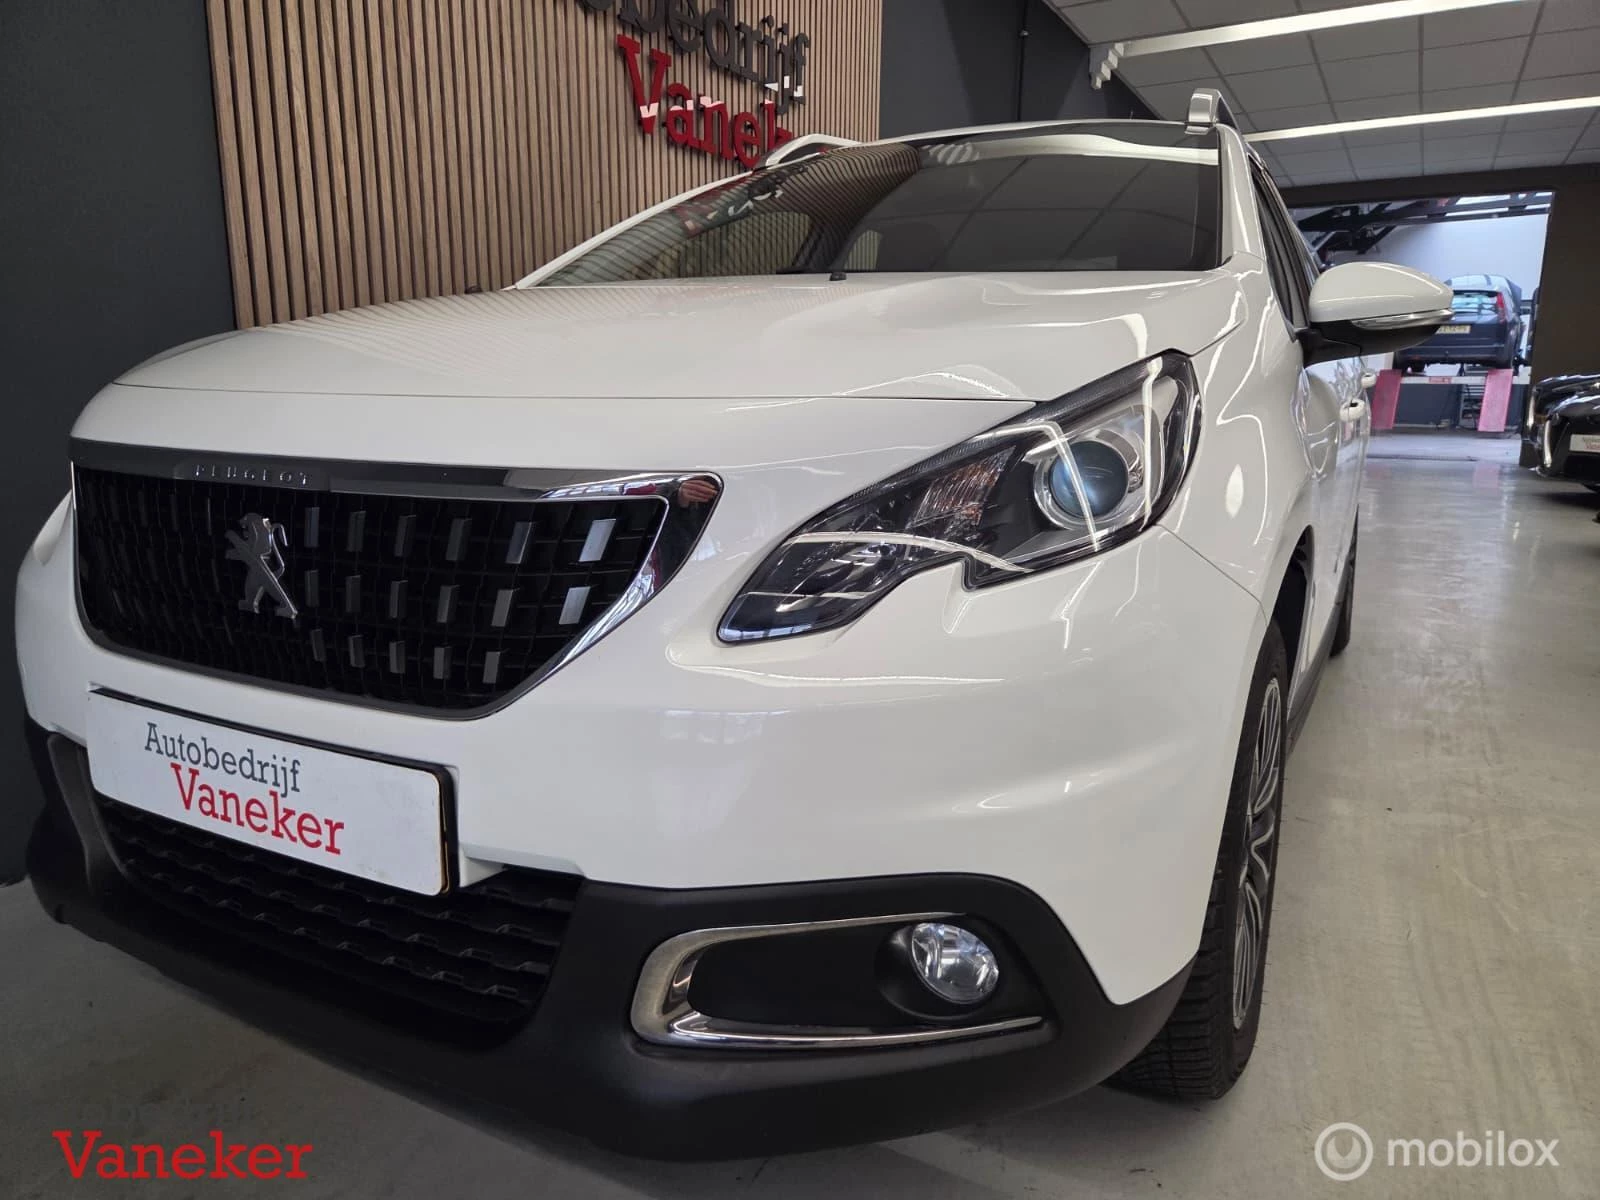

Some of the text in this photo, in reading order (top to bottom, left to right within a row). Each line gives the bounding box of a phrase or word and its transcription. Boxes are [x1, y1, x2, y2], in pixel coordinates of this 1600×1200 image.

[578, 0, 810, 115] edrijf
[616, 34, 794, 168] Vanek
[144, 722, 301, 798] Autobedrijf
[170, 762, 345, 856] Vaneker
